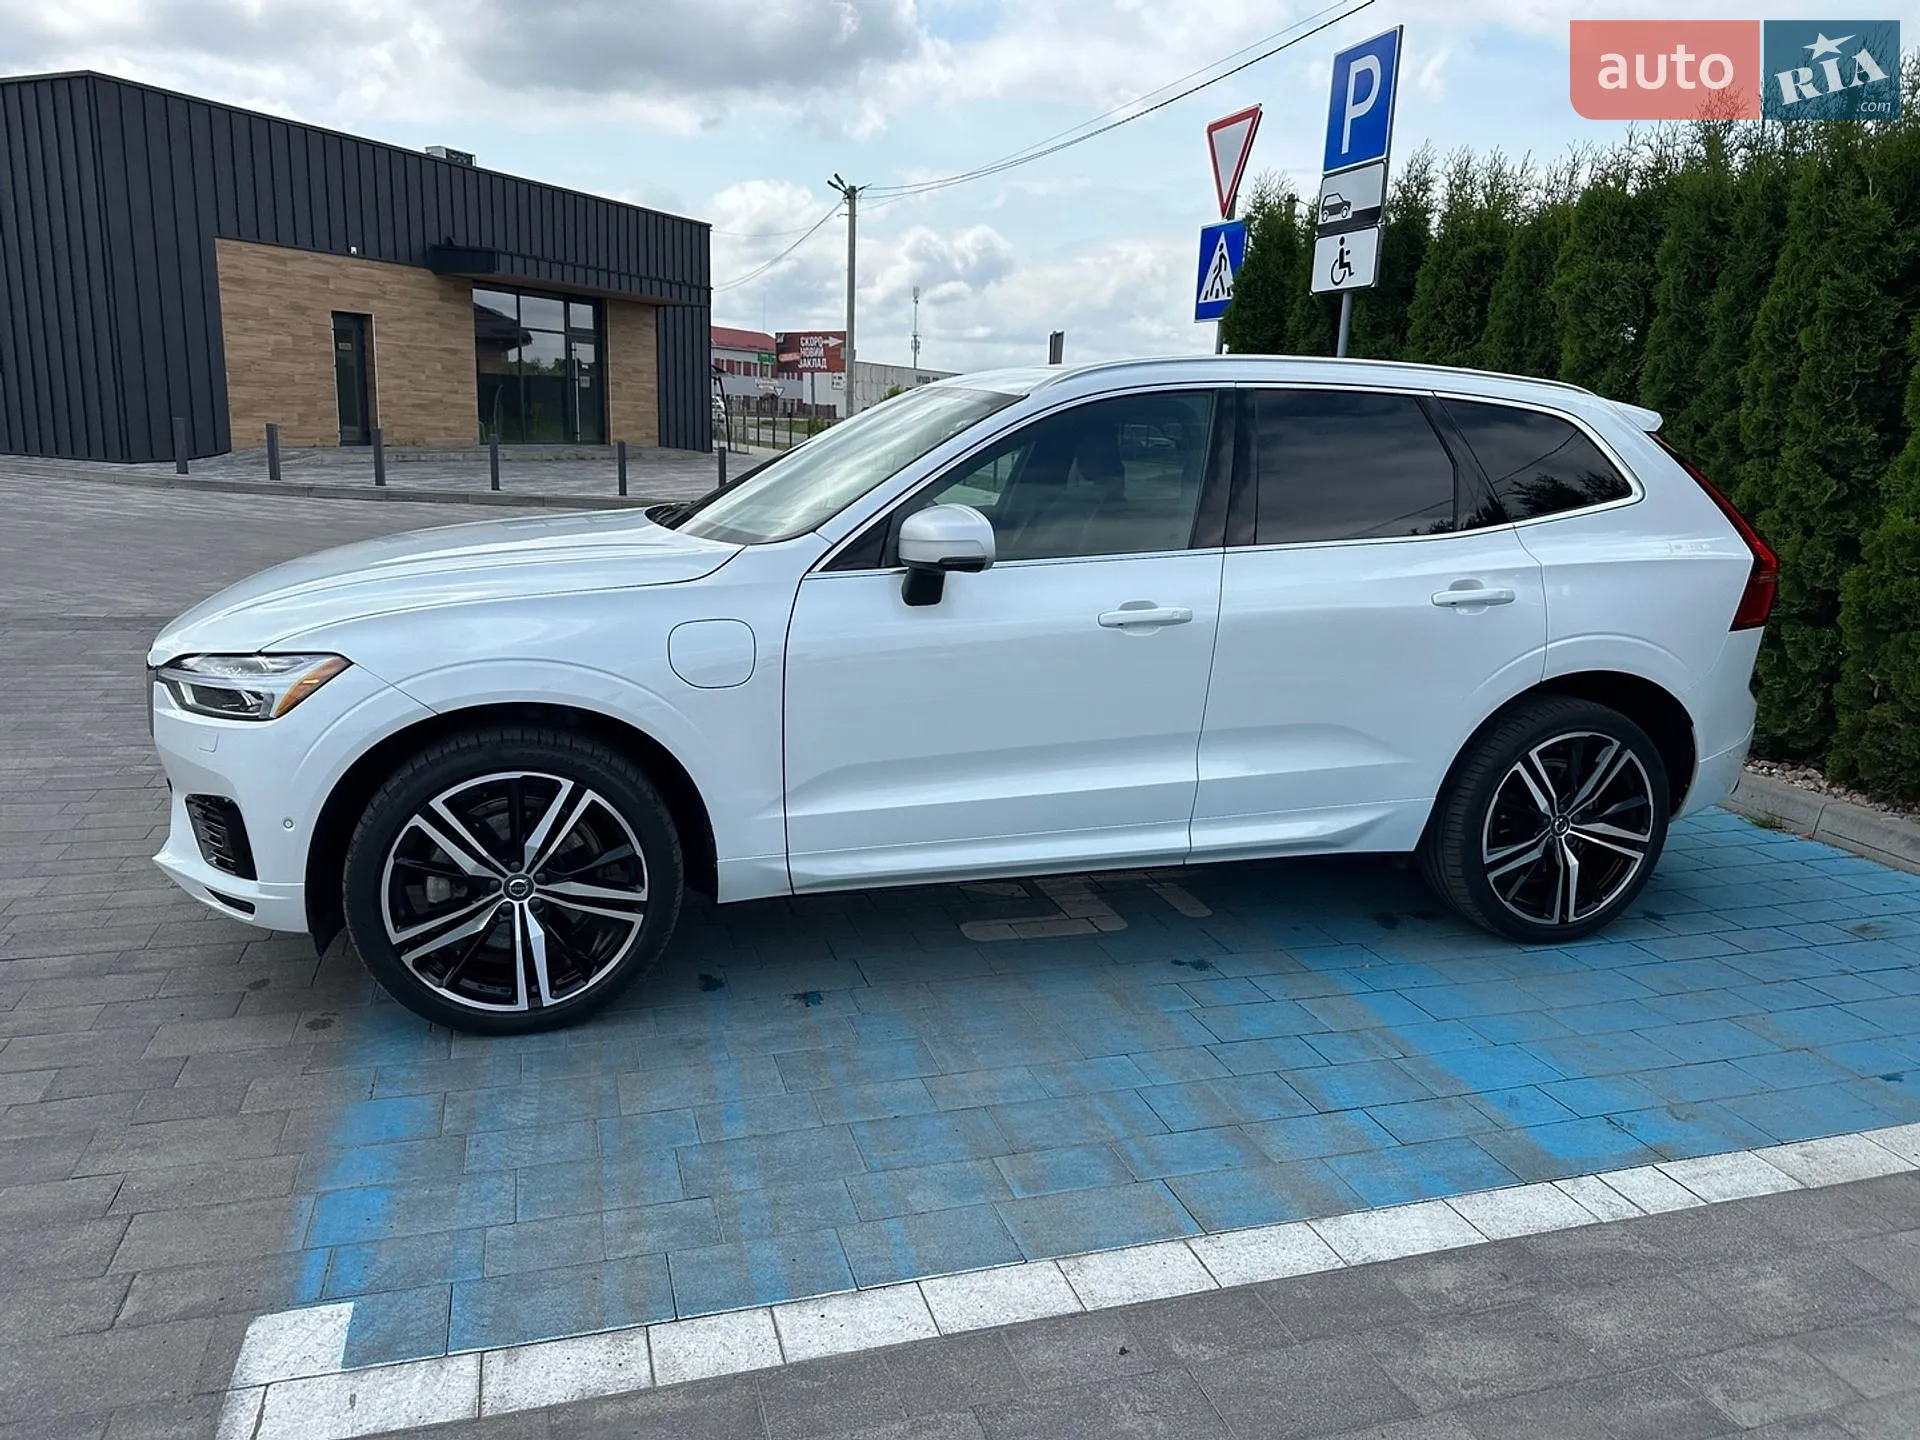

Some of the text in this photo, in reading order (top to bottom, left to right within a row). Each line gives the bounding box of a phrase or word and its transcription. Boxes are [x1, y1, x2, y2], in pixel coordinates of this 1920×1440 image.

[1341, 54, 1382, 155] P
[800, 336, 824, 347] СКОРО
[798, 358, 827, 369] ЗАКЛАД
